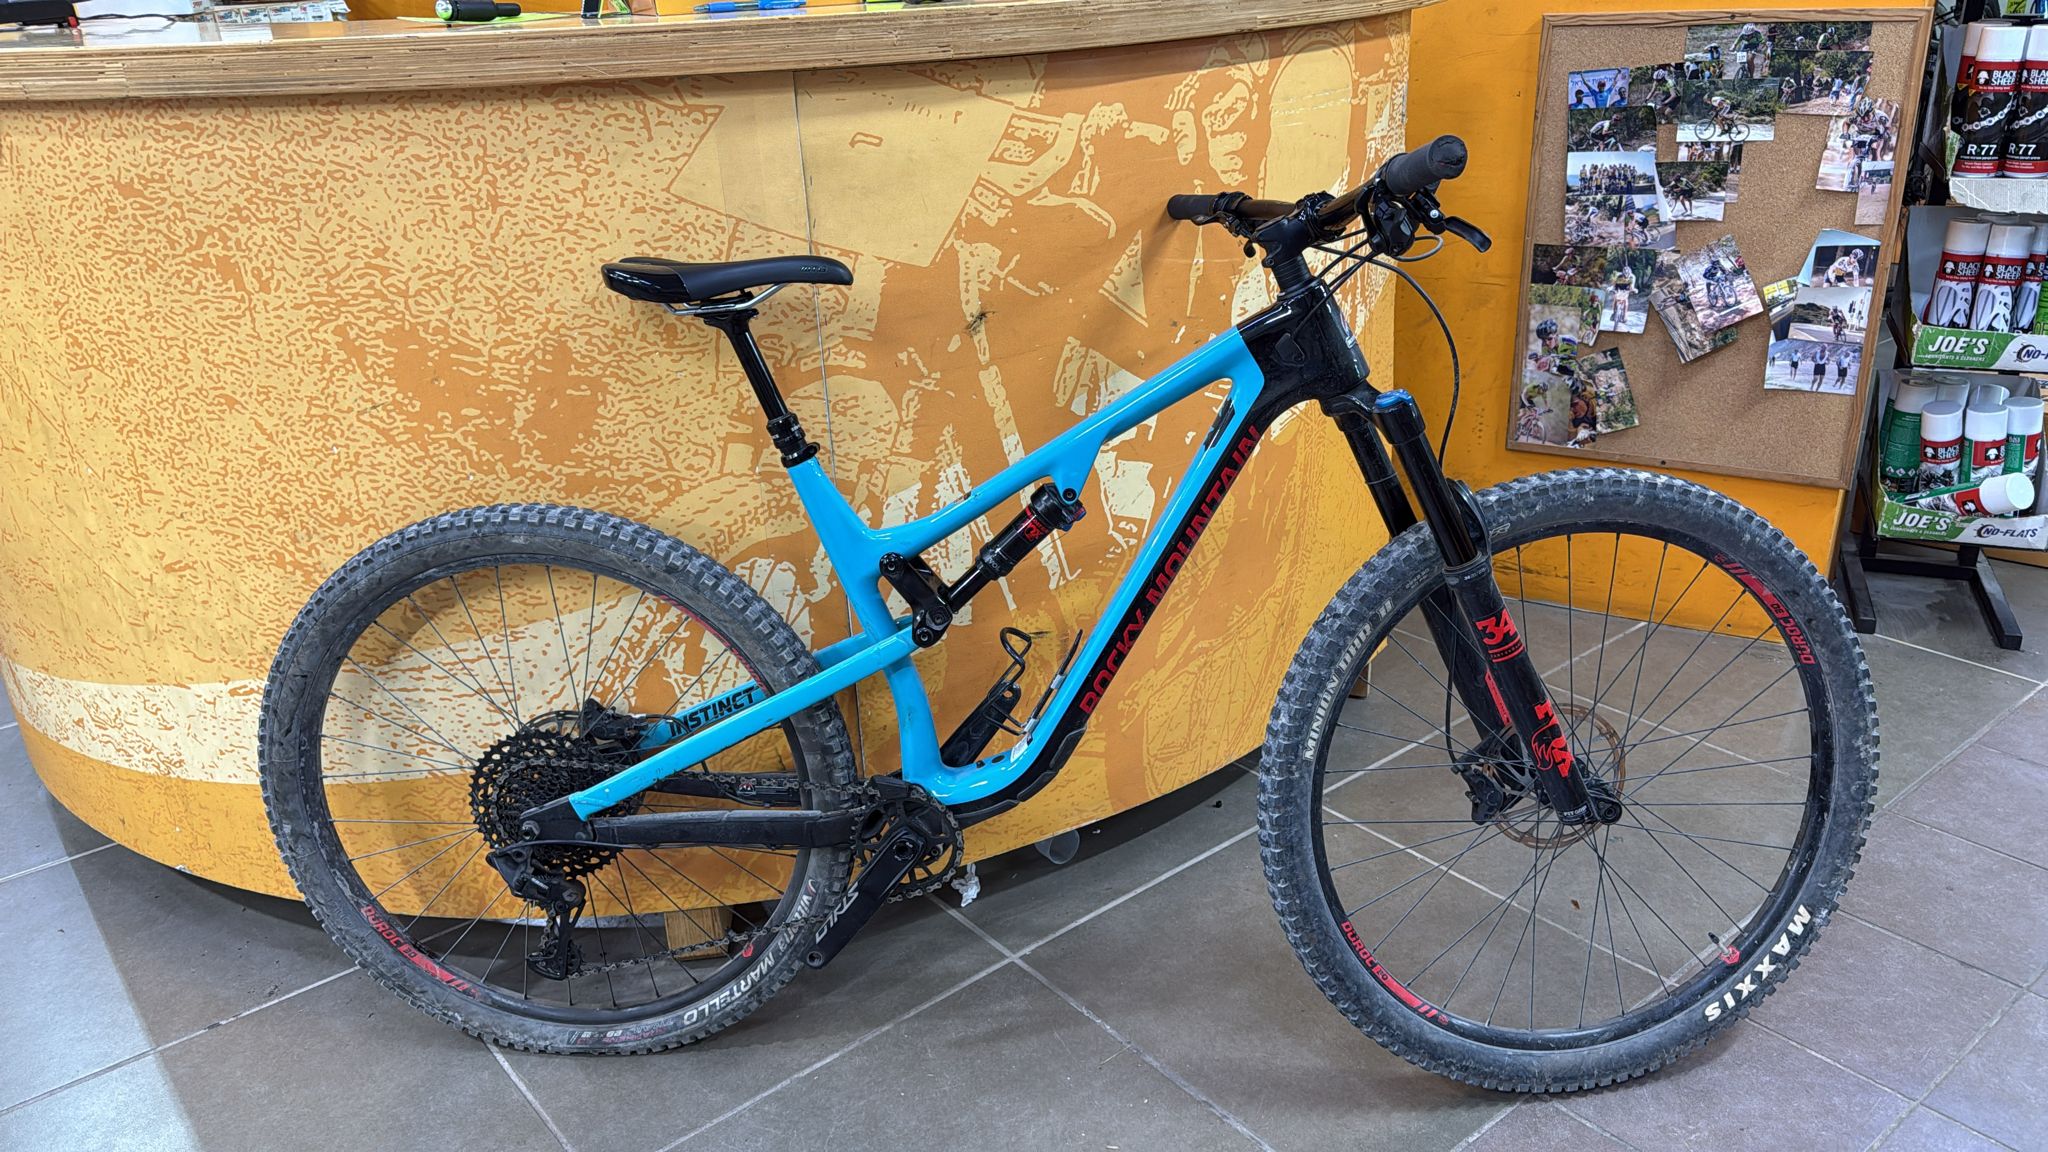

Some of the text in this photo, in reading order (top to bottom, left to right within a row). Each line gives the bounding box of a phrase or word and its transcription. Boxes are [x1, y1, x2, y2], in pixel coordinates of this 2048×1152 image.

[1995, 271, 2021, 280] SHEEP
[1997, 264, 2022, 273] BLACK
[1928, 335, 1989, 355] JOE'S
[1893, 512, 1951, 531] JOE'S
[1983, 527, 2038, 538] NO-FLATS
[1079, 425, 1261, 715] ROCKY MOUNTAIN
[1475, 607, 1517, 645] 34
[1303, 671, 1341, 761] MINION
[1338, 622, 1373, 673] DHR
[668, 685, 756, 737] INSTINCT
[1704, 904, 1811, 1022] MAXXIS
[683, 951, 777, 1026] MARTELLO
